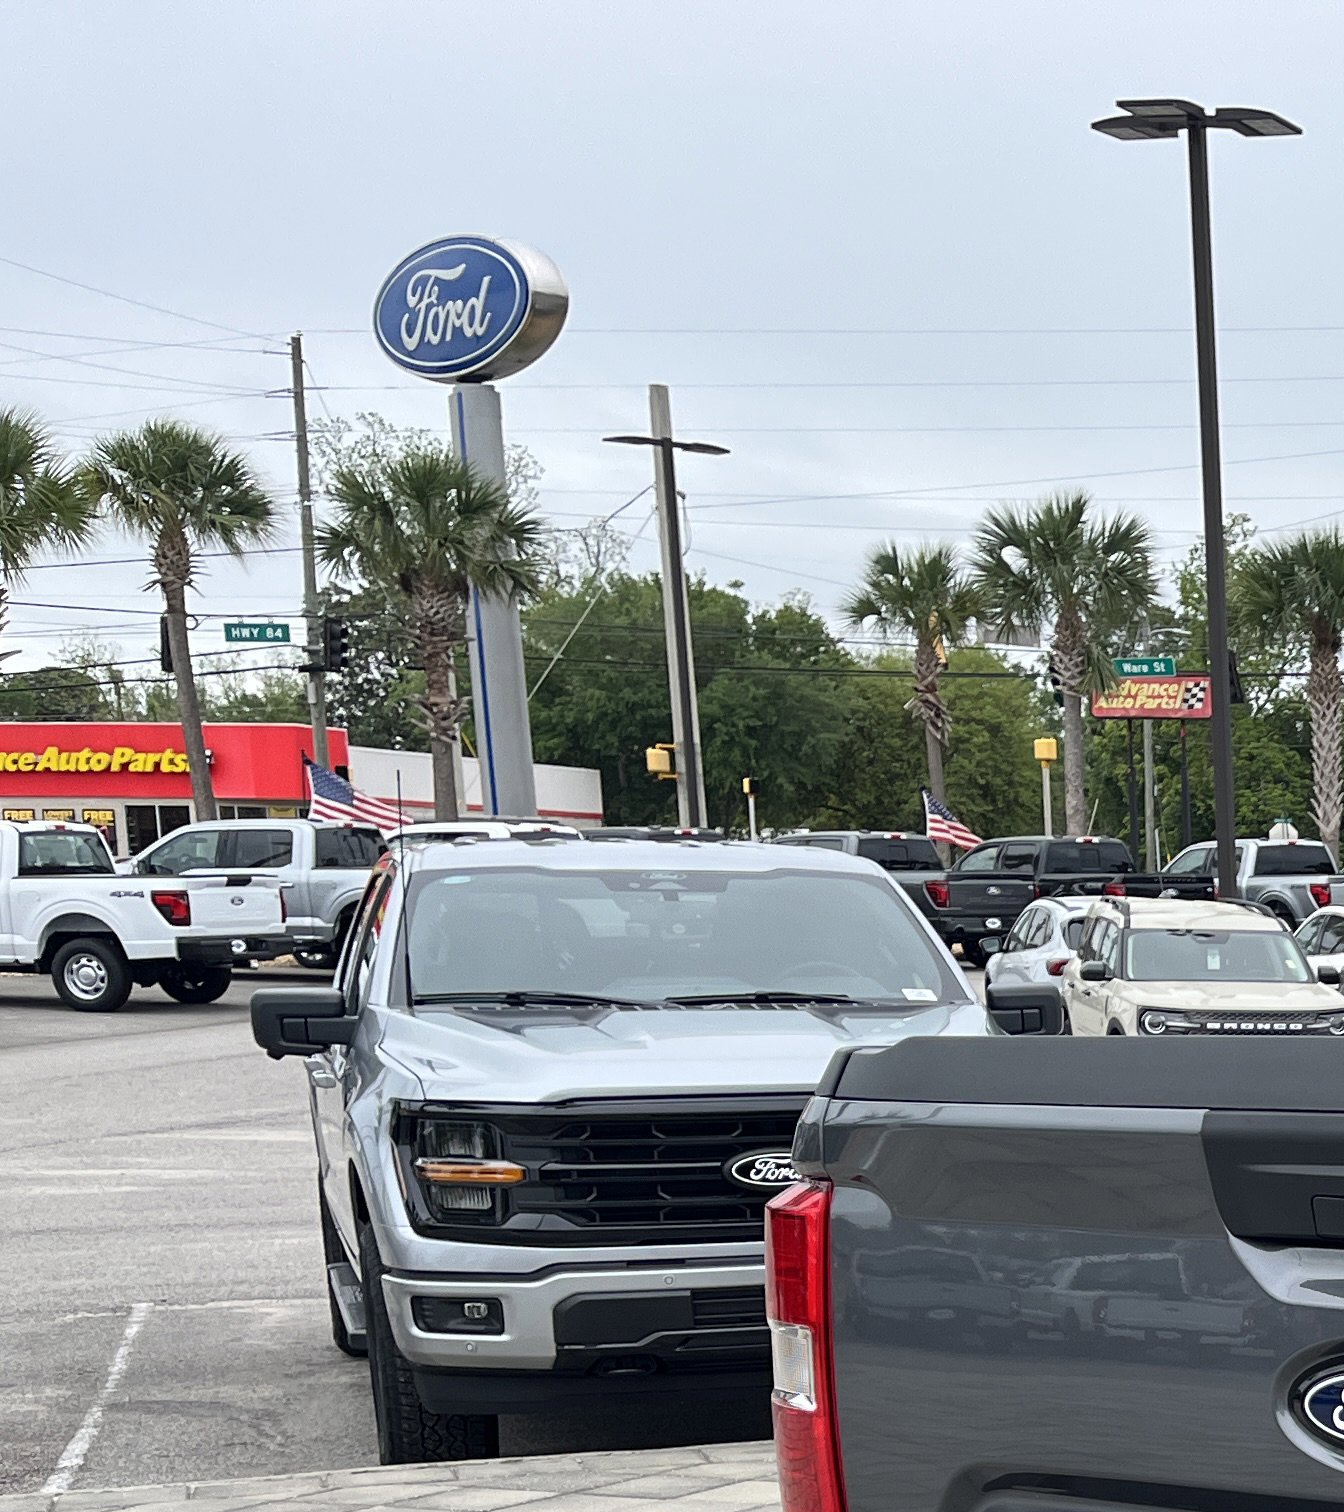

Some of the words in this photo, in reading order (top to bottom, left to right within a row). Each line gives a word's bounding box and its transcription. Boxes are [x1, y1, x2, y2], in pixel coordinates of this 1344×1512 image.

[400, 263, 492, 351] Ford
[231, 627, 260, 638] HWY
[1122, 662, 1149, 673] Ware
[1152, 661, 1166, 673] St
[1095, 695, 1134, 709] Auto
[1134, 695, 1176, 709] Parts
[36, 746, 111, 772] Auto
[110, 746, 189, 774] Parts
